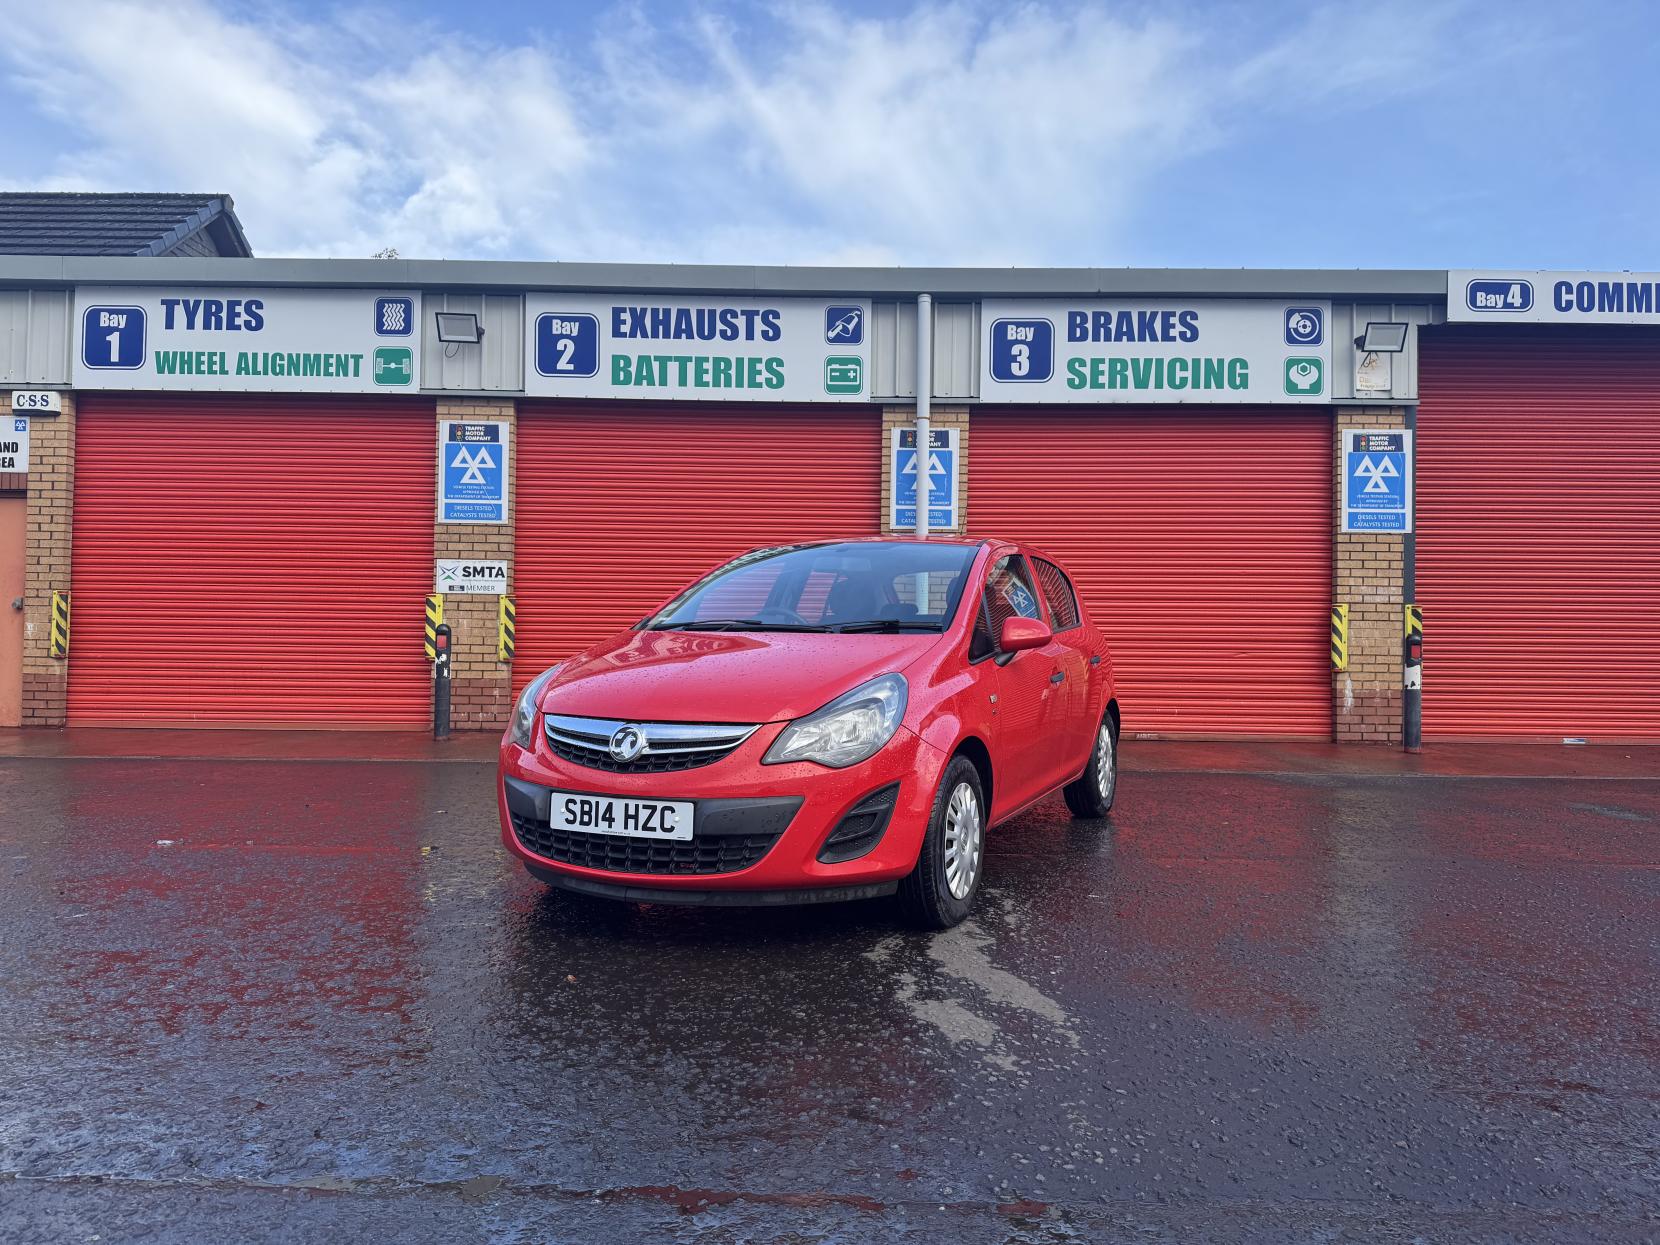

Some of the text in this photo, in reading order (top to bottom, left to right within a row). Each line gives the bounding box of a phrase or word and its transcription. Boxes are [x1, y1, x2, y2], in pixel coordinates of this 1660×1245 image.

[1476, 284, 1522, 308] Bay 4
[100, 312, 127, 328] Bay
[161, 299, 264, 331] TYRES
[552, 319, 579, 337] Bay
[611, 307, 781, 342] EXHAUSTS
[1068, 311, 1199, 342] BRAKES
[106, 331, 120, 363] 1
[1007, 325, 1034, 342] Bay
[155, 350, 363, 378] WHEEL ALIGNMENT
[556, 339, 575, 370] 2
[1010, 344, 1030, 376] 3
[611, 355, 785, 389] BATTERIES
[1066, 357, 1249, 390] SERVICING
[462, 566, 505, 578] SMTA
[564, 798, 676, 833] SB14 HZC
